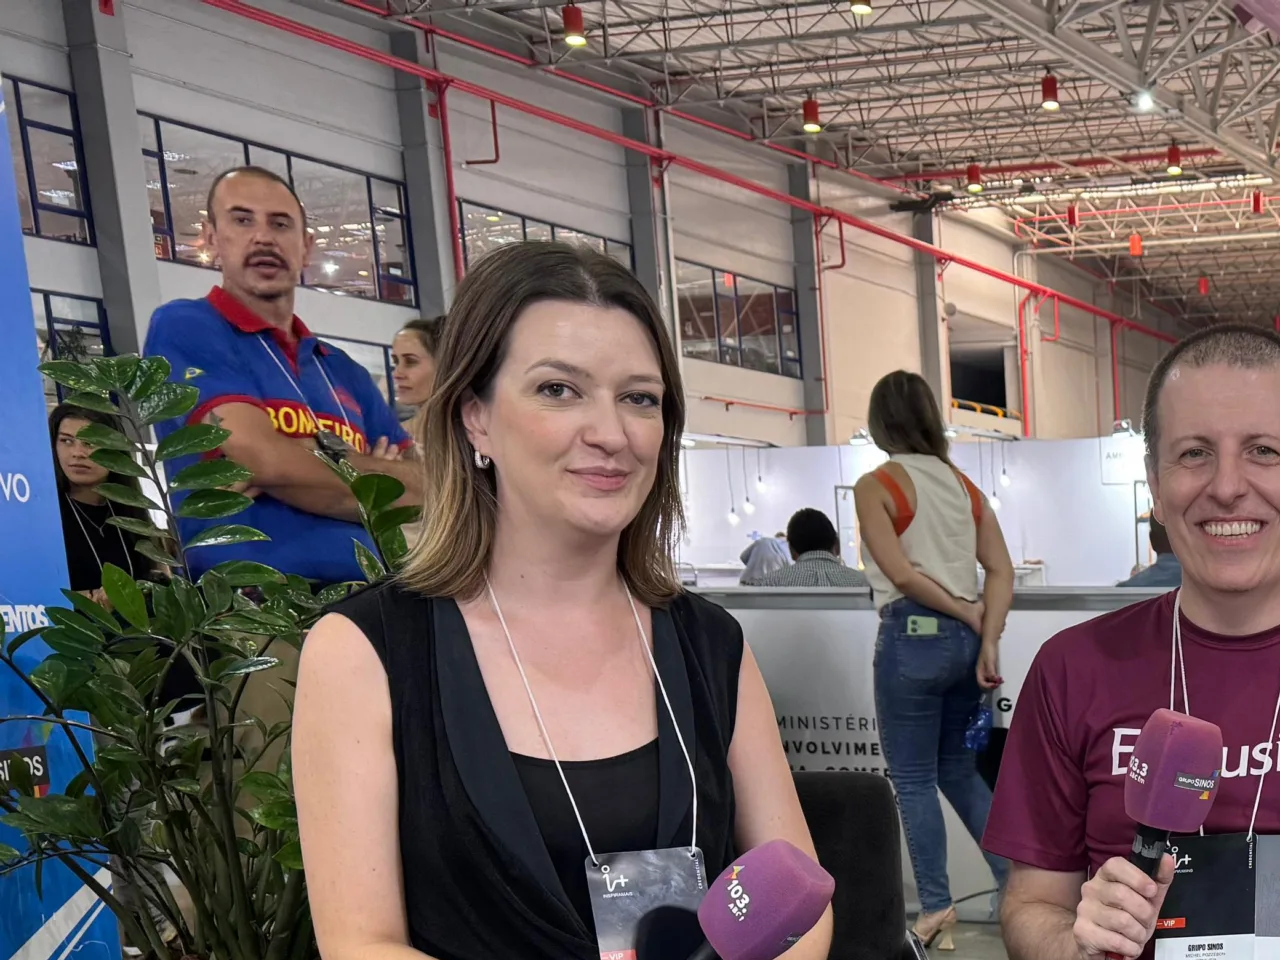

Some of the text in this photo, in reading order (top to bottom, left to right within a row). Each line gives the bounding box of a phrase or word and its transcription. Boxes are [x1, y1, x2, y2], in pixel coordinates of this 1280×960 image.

[1194, 778, 1215, 788] SINOS
[694, 858, 703, 889] CREDENCIAL
[1187, 943, 1224, 952] GRUPO SINOS
[608, 952, 624, 960] VIP
